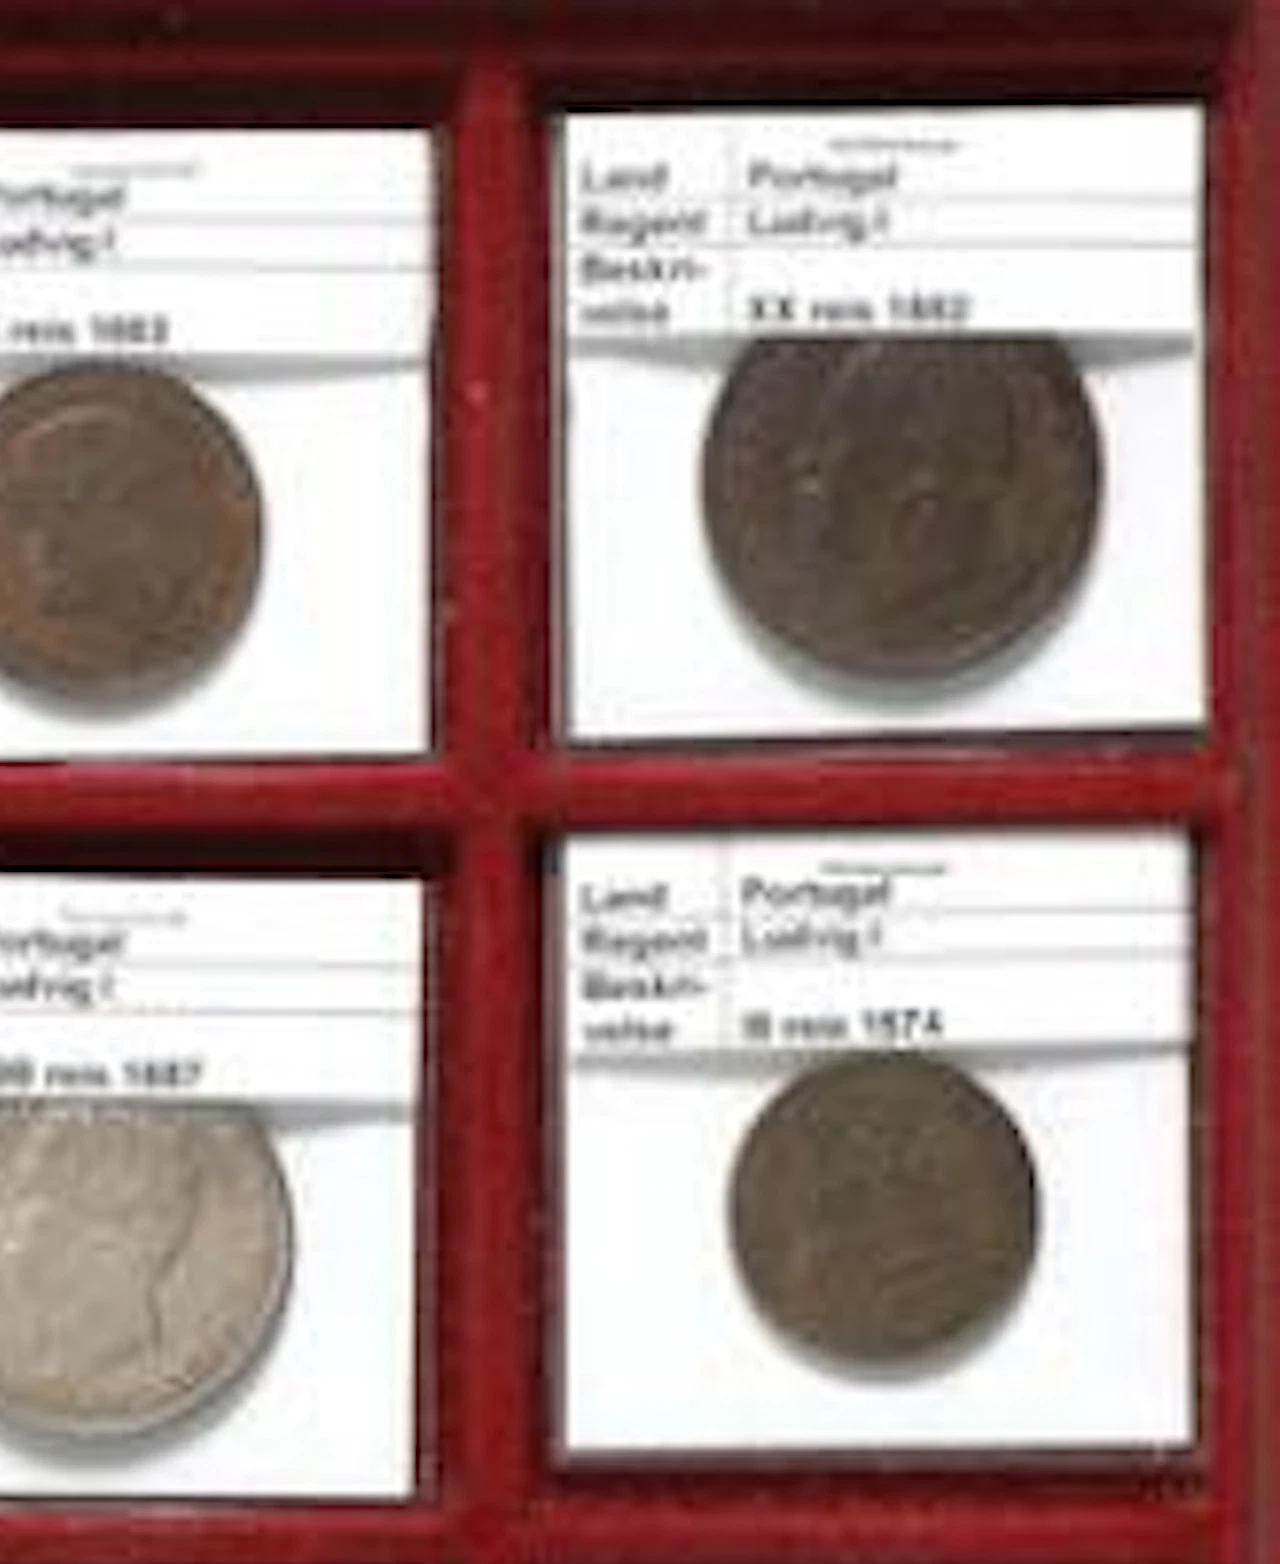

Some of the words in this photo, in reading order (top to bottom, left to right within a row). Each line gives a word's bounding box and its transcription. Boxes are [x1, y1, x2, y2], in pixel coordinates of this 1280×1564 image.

[580, 163, 670, 194] Land
[747, 161, 899, 199] Portugal
[578, 206, 707, 247] Regent
[746, 207, 868, 246] Ludvig
[581, 300, 671, 326] velse
[580, 882, 669, 916] Land
[739, 870, 893, 917] Portugal
[580, 924, 709, 965] Regent
[740, 922, 861, 961] Ludvig
[584, 1016, 675, 1045] velse
